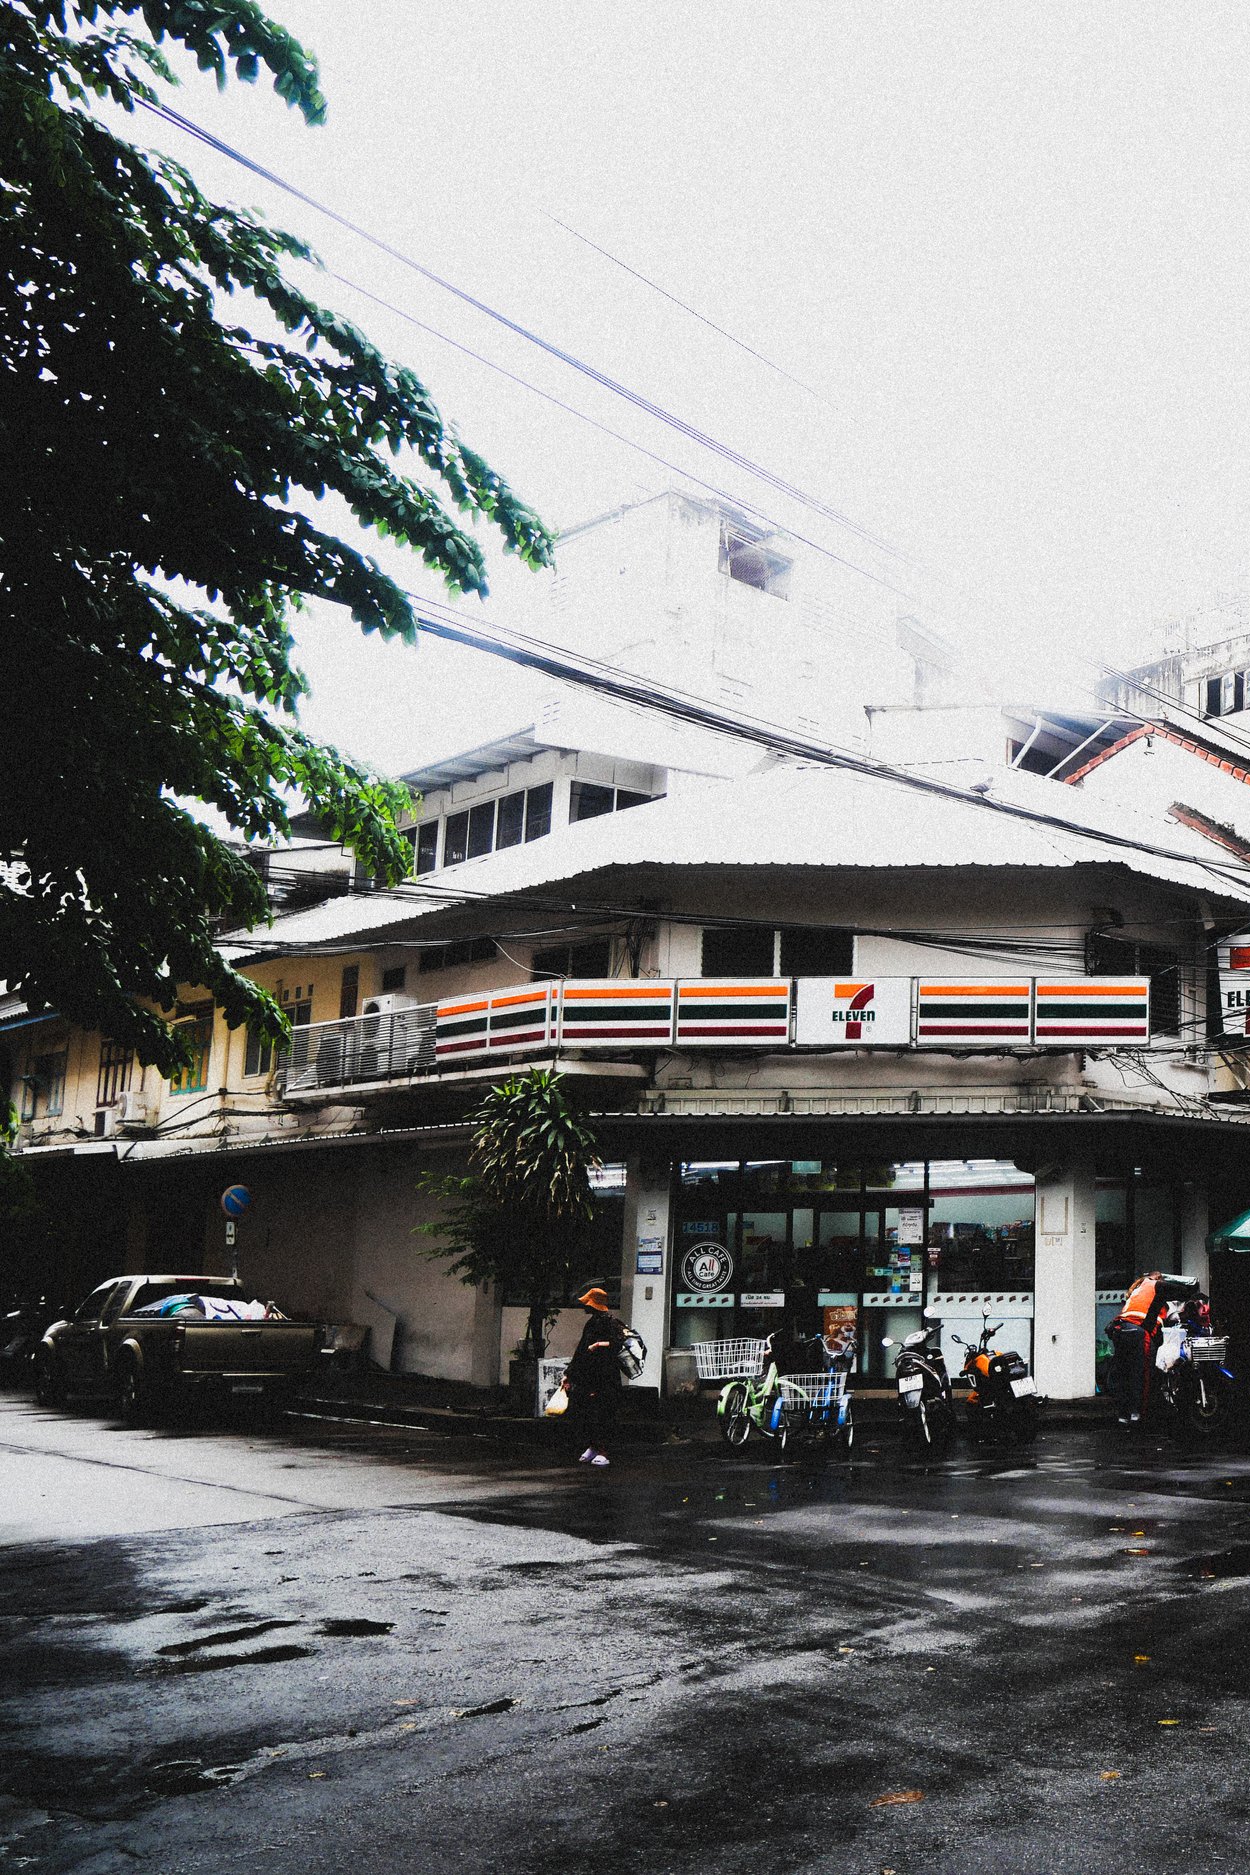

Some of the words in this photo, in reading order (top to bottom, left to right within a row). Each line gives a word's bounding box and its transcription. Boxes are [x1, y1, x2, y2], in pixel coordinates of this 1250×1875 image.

[689, 1247, 706, 1264] ALL
[708, 1247, 727, 1263] CAFE
[699, 1258, 715, 1272] All
[702, 1281, 717, 1289] GREAT
